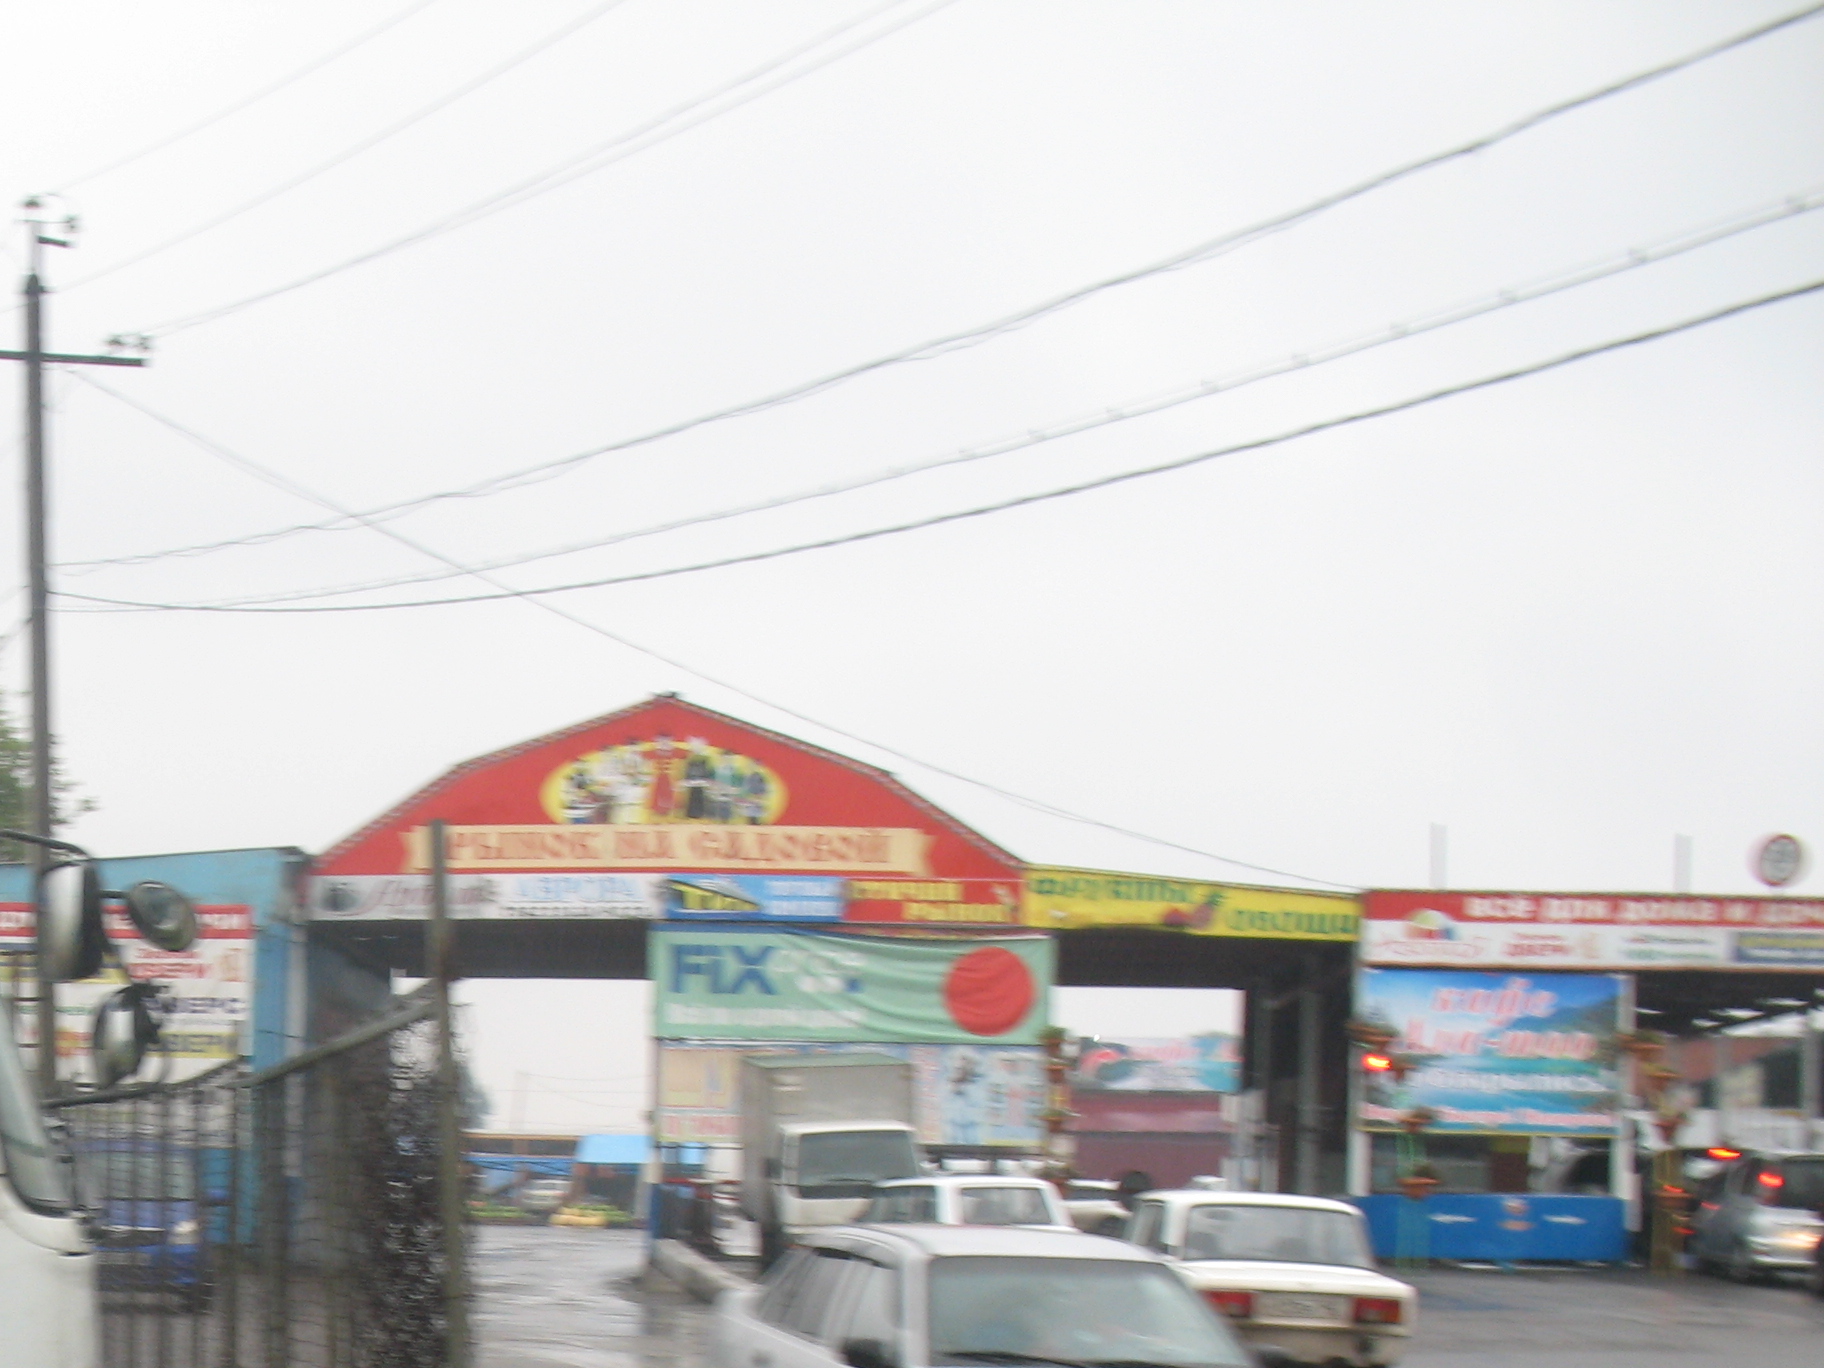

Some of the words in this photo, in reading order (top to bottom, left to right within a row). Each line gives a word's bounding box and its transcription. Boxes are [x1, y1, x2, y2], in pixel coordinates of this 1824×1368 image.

[449, 832, 602, 860] РЫНОК
[614, 831, 674, 860] НА
[687, 829, 891, 863] САДОВОЙ
[1030, 877, 1194, 905] ФРУКТЫ
[1228, 909, 1358, 935] ОВОЩИ
[1432, 976, 1558, 1027] кафе
